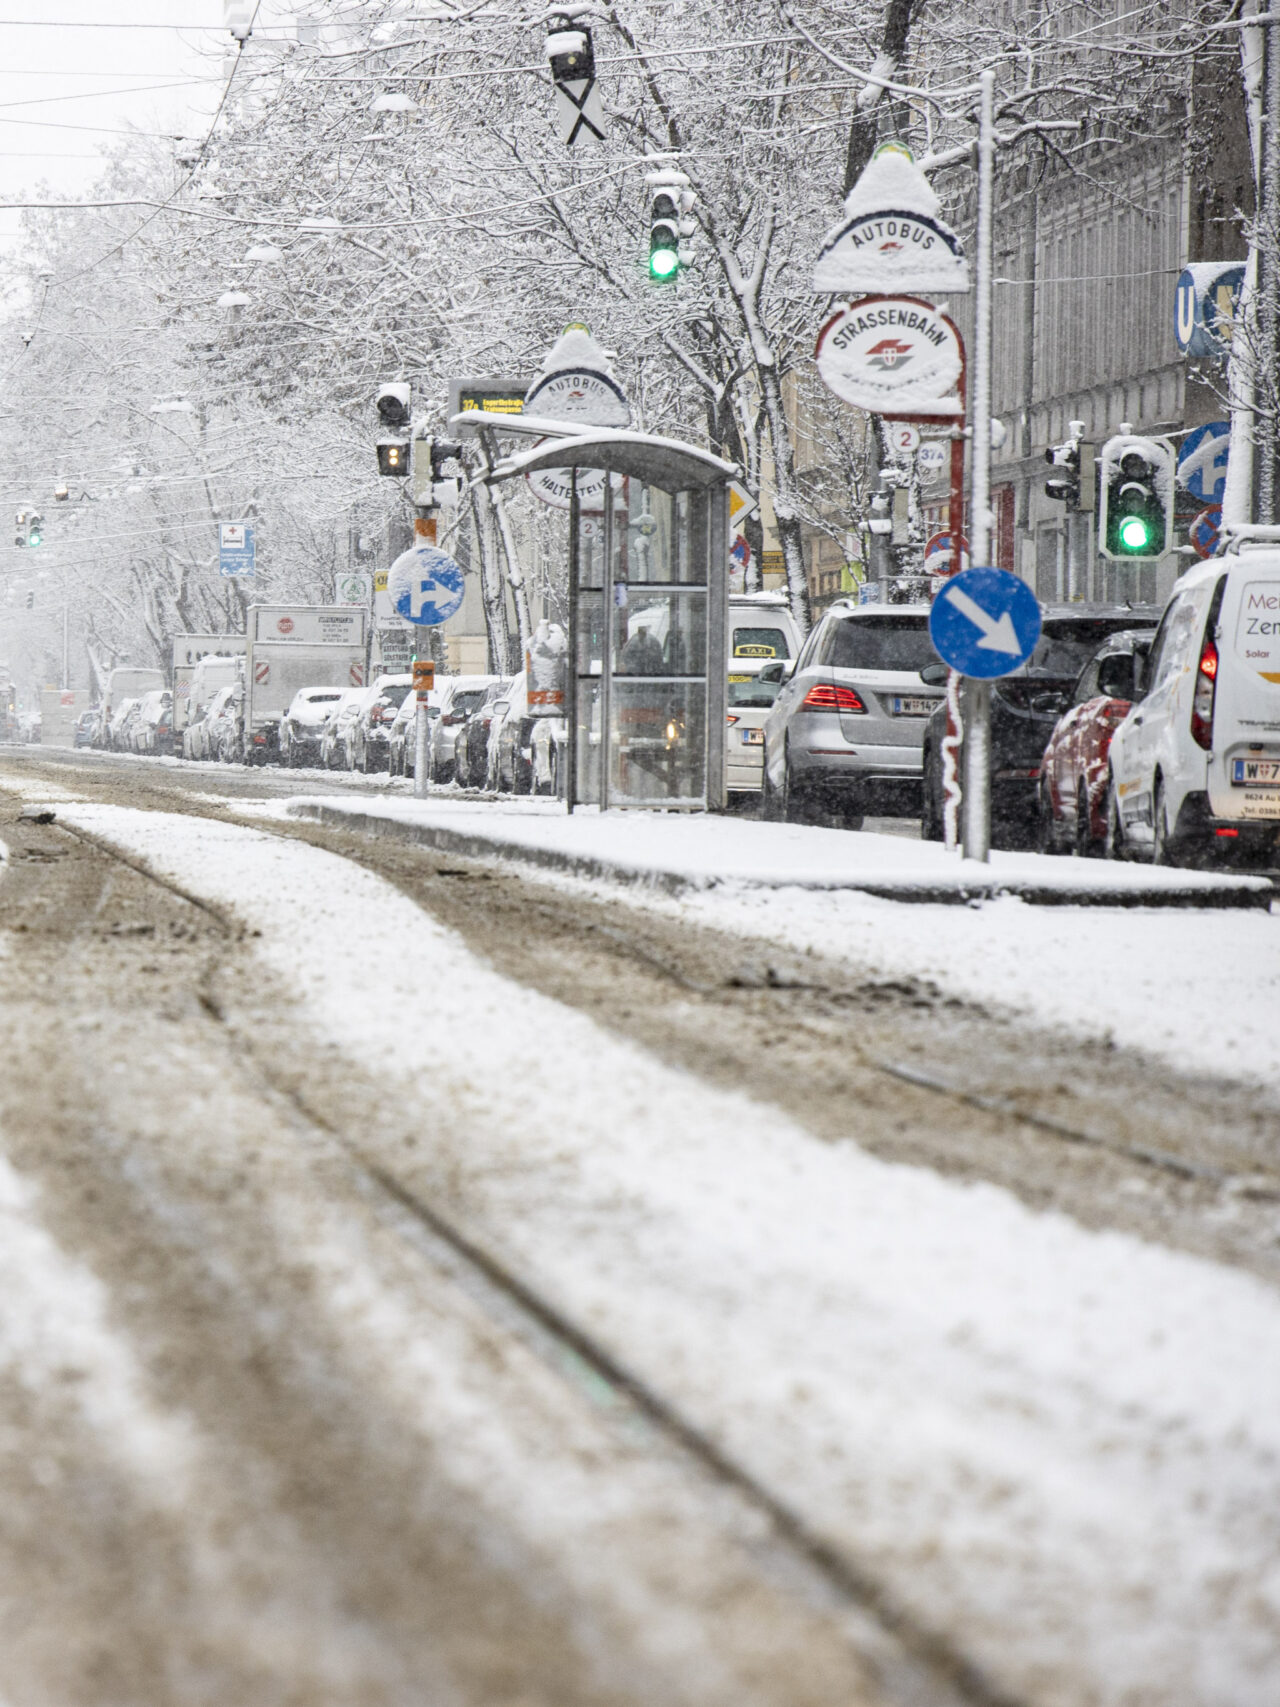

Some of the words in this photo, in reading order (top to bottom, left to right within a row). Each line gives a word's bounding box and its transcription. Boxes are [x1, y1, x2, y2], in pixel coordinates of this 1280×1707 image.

[851, 221, 935, 250] AUTOBUS
[1178, 286, 1194, 344] U
[832, 309, 948, 350] STRASSENBAHN
[900, 432, 912, 446] 2
[921, 449, 944, 460] 37A
[584, 523, 593, 534] 2
[1245, 649, 1270, 658] Solar
[1247, 763, 1259, 779] W
